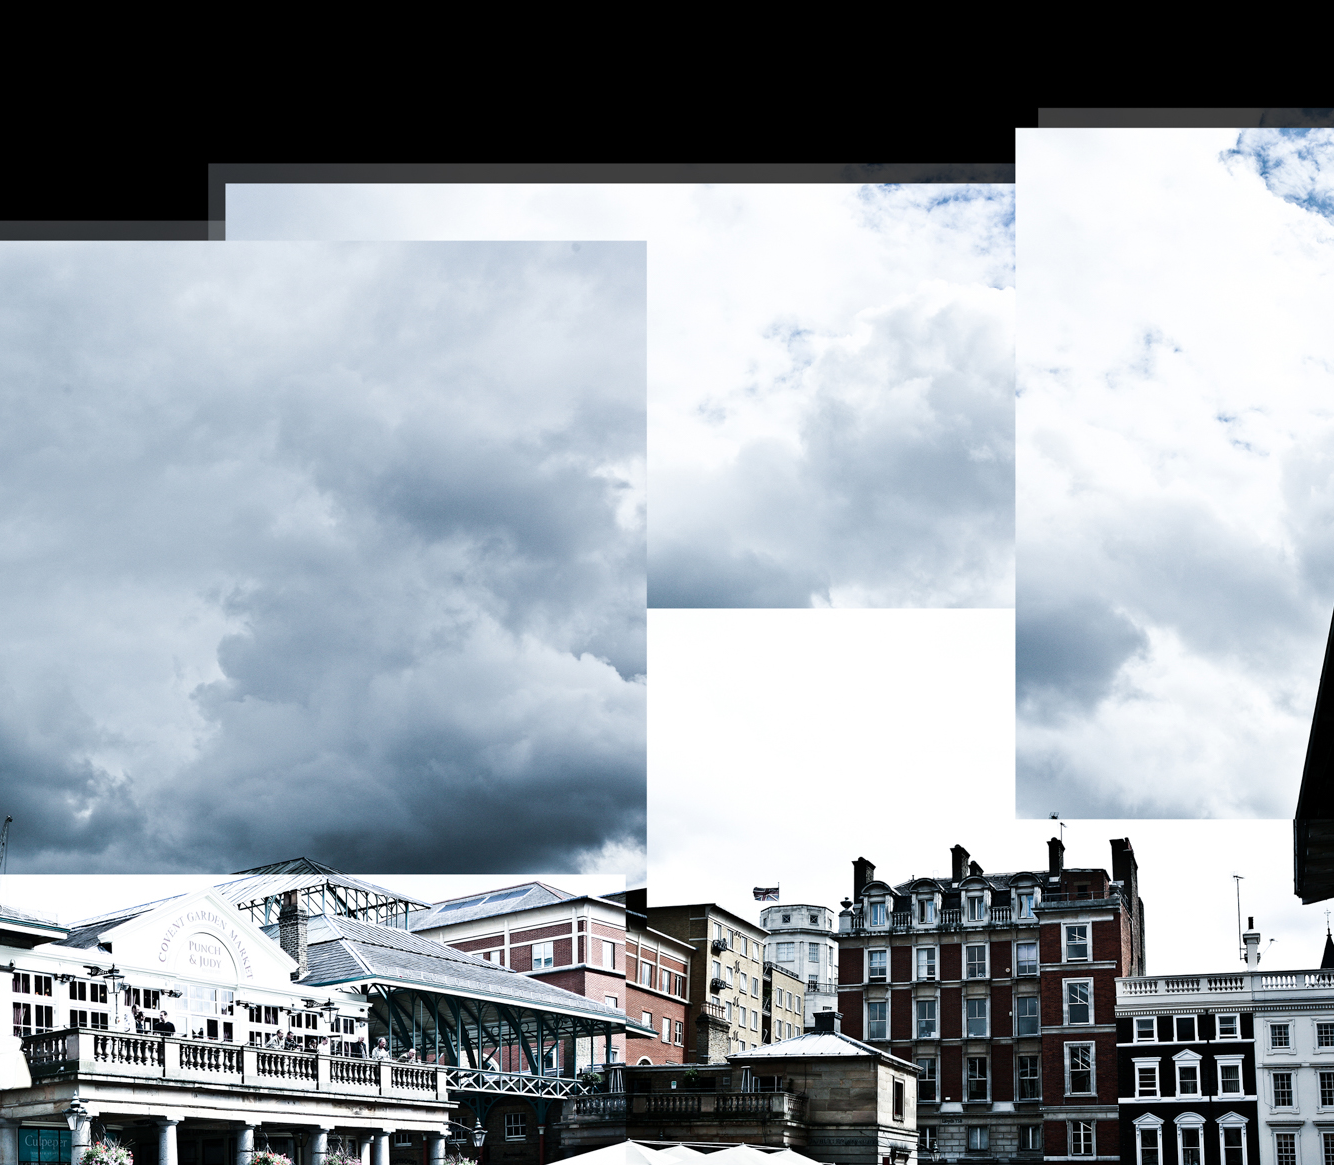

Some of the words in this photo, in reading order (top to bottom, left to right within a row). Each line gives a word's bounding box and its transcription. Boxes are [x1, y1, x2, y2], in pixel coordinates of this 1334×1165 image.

[158, 916, 186, 963] COVENT
[186, 910, 227, 930] GARDEN
[229, 929, 254, 979] MARKET
[188, 940, 221, 956] PUNCH
[189, 954, 197, 965] &
[199, 955, 222, 968] JUDY
[24, 1134, 68, 1150] Culpeper
